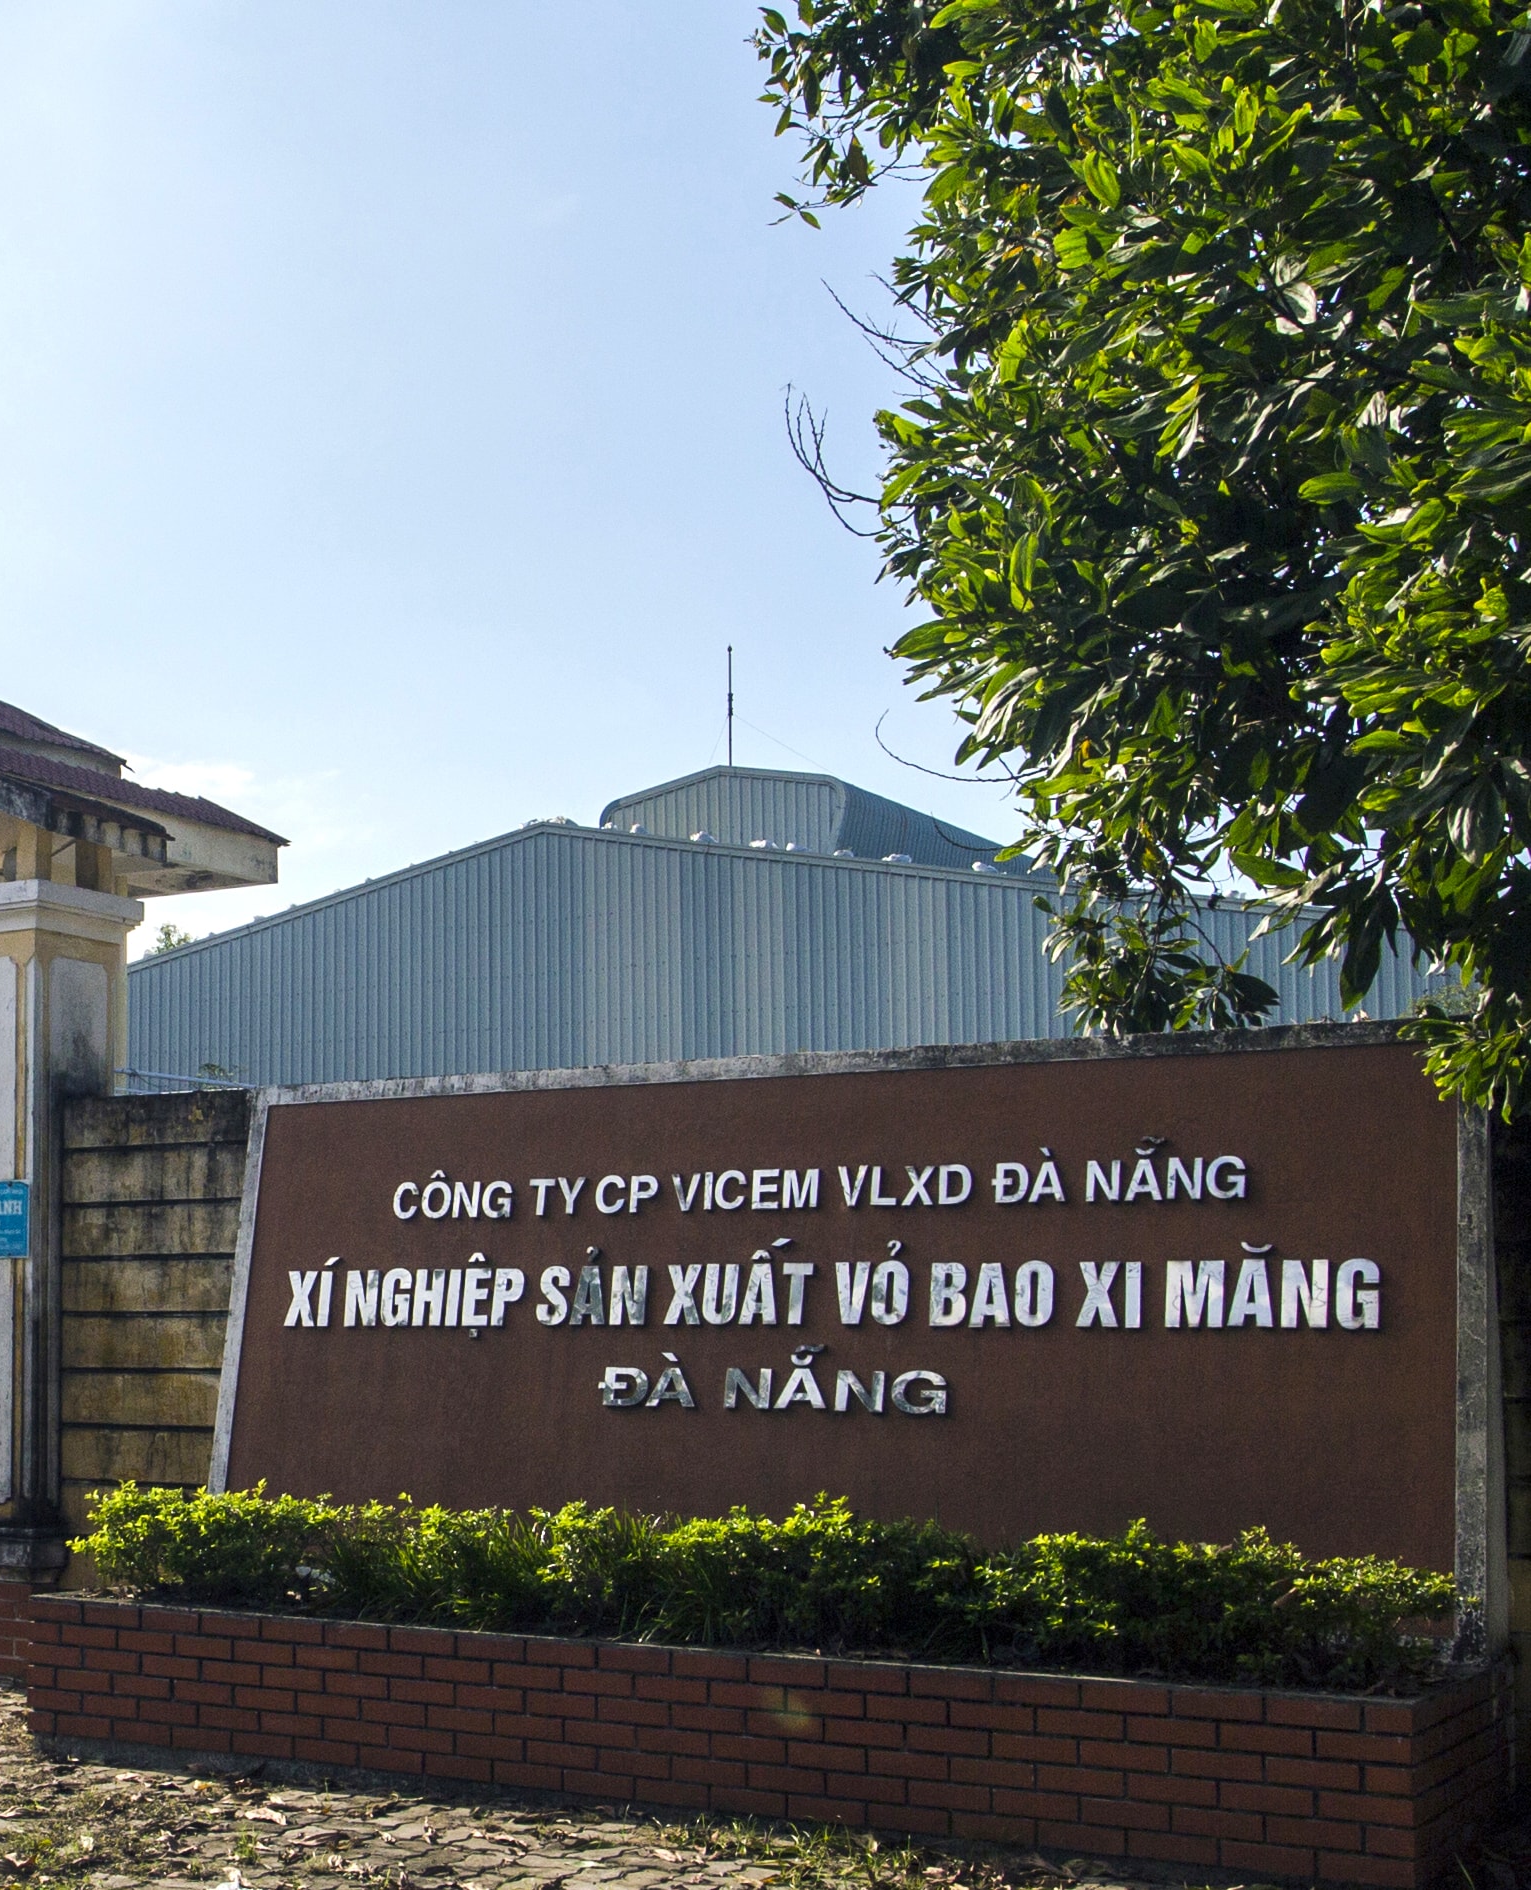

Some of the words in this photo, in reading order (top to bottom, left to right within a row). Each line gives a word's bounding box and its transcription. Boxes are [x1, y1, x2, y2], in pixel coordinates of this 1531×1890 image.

[392, 1169, 514, 1220] CÔNG
[528, 1176, 587, 1216] TY
[594, 1174, 659, 1215] CP
[671, 1168, 820, 1212] VICEM
[837, 1163, 972, 1207] VLXD
[991, 1147, 1066, 1204] ĐÀ
[1085, 1136, 1247, 1202] NẴNG
[283, 1256, 342, 1328] XÍ
[343, 1251, 526, 1339] NGHIỆP
[535, 1246, 650, 1327] SẢN
[663, 1237, 815, 1326] XUẤT
[835, 1240, 910, 1327] VỎ
[928, 1259, 1055, 1328] BAO
[1075, 1260, 1142, 1329] XI
[1164, 1241, 1381, 1330] MĂNG
[597, 1351, 696, 1408] ĐÀ
[723, 1344, 948, 1415] NẴNG
